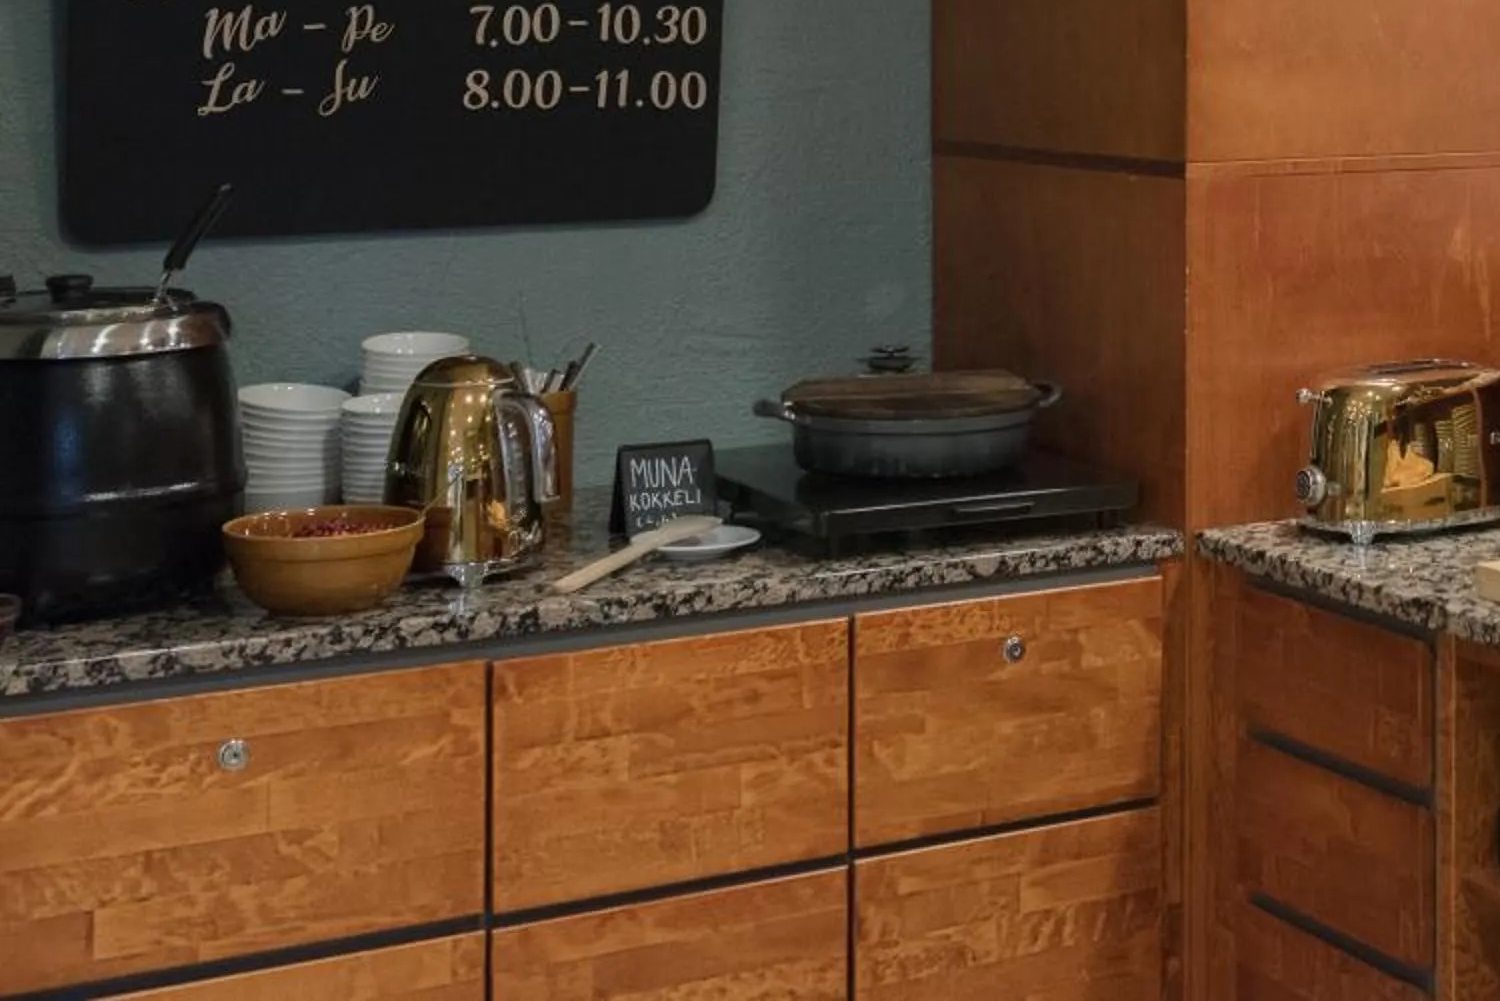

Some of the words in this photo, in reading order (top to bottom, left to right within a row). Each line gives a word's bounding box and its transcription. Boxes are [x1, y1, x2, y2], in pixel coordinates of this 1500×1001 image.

[202, 3, 288, 60] Ma
[340, 3, 396, 52] Pe
[196, 61, 265, 117] La
[317, 57, 380, 117] Su
[628, 488, 701, 512] KOKKELI
